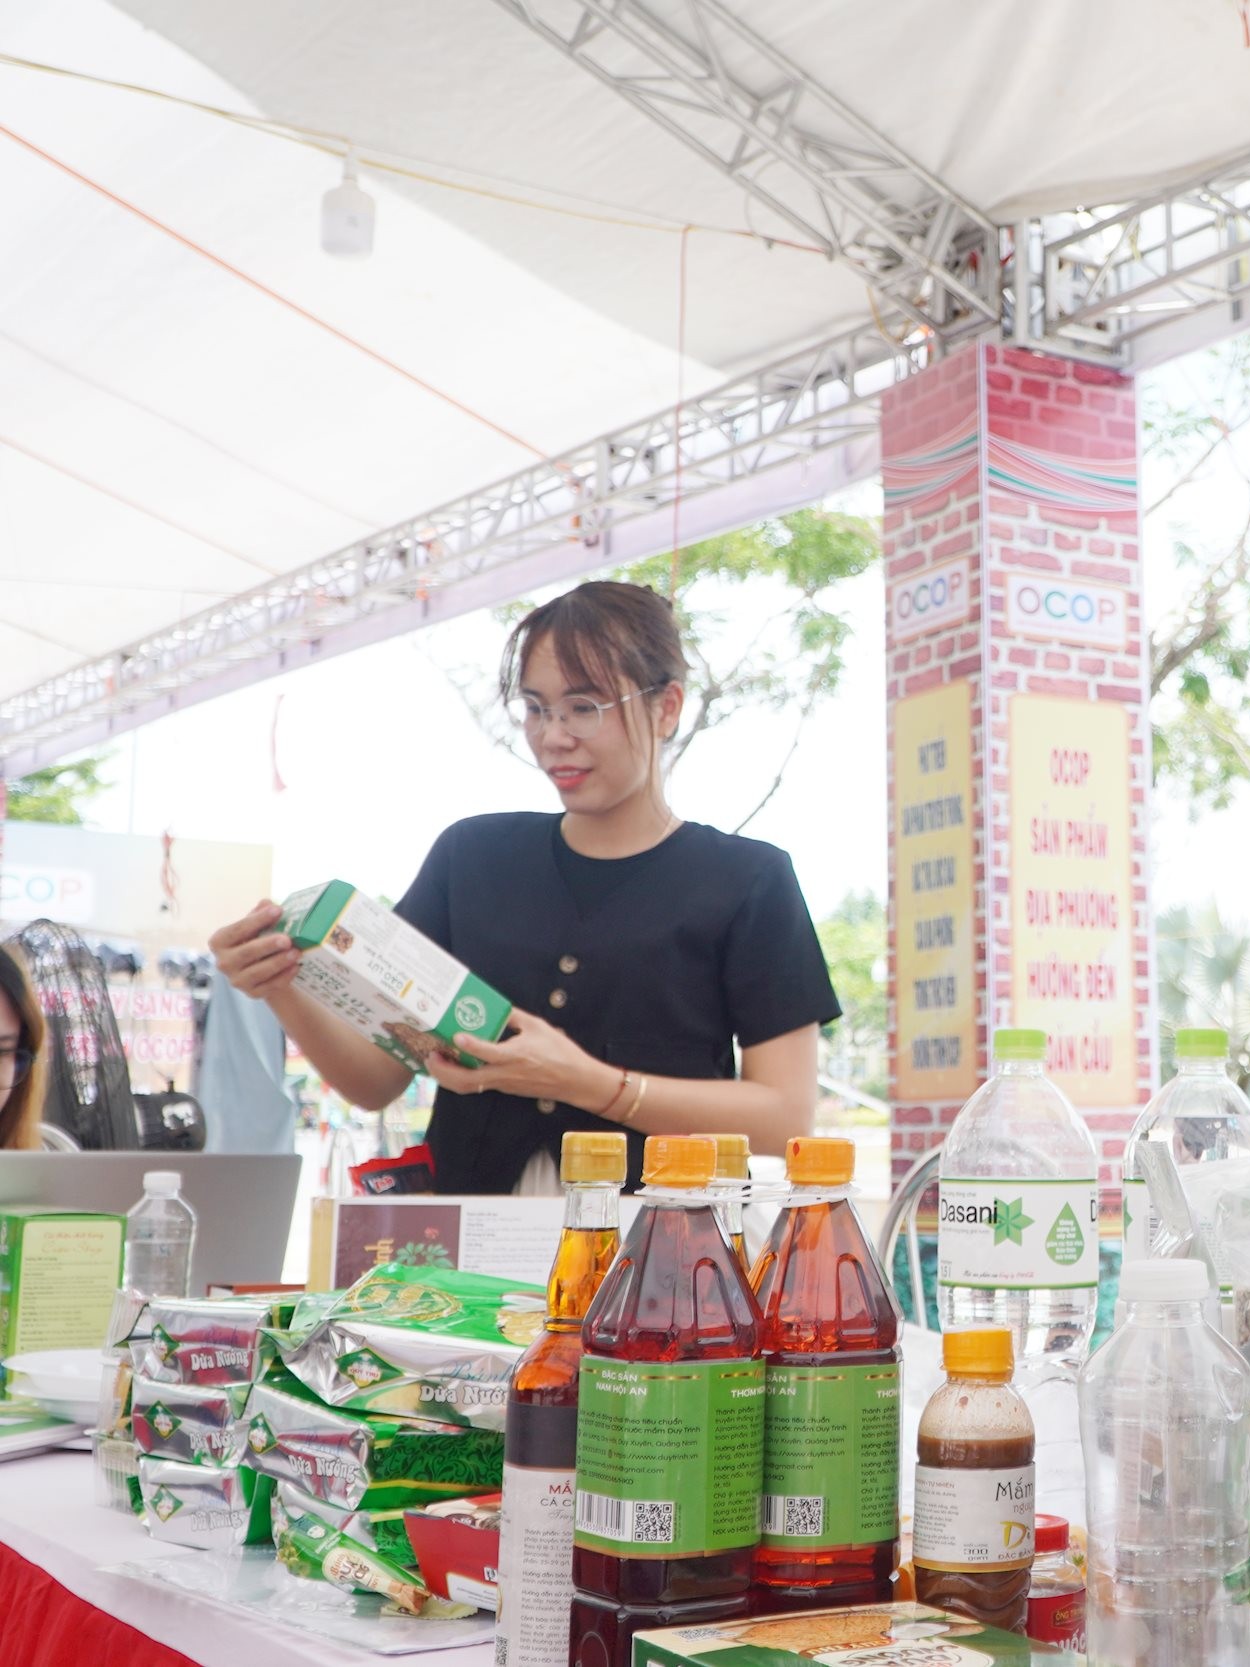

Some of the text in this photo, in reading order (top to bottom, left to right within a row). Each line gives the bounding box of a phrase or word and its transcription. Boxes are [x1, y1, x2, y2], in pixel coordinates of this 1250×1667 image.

[897, 571, 961, 619] OCOP
[1017, 586, 1116, 623] OCOP
[1050, 746, 1091, 786] OCOP
[941, 1198, 998, 1224] Dasani
[618, 1370, 638, 1382] SẢN
[420, 1385, 458, 1404] Dừa
[596, 1382, 647, 1396] NAM HỘI AN
[779, 1387, 797, 1396] AN
[549, 1480, 572, 1494] MẮ
[996, 1477, 1033, 1501] Mắm
